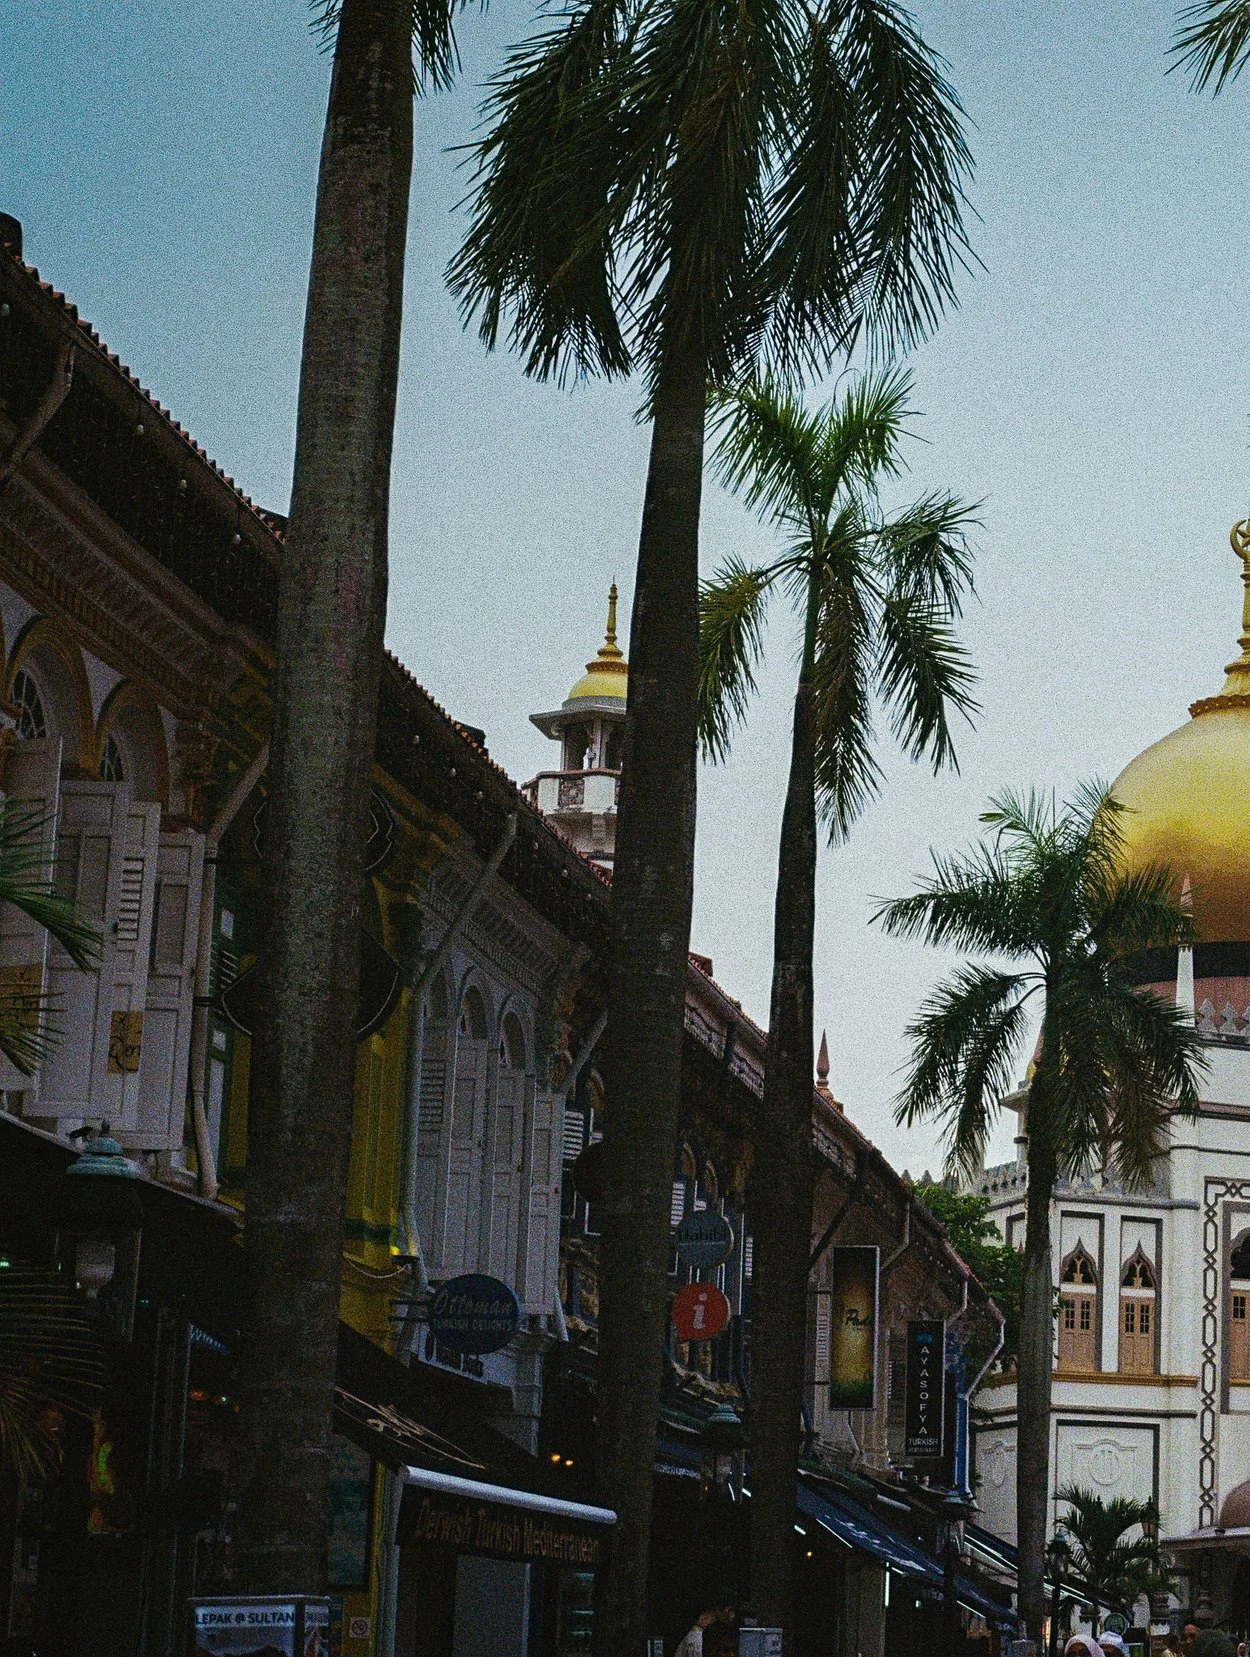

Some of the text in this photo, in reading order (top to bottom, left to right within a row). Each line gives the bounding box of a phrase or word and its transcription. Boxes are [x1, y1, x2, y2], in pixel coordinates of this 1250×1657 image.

[435, 1288, 512, 1315] Ottoman
[919, 1345, 930, 1435] AYASOFYA
[908, 1438, 938, 1446] TURKISH
[474, 1507, 520, 1553] Turkish
[196, 1612, 232, 1625] LEPAK
[235, 1612, 245, 1624] @
[248, 1611, 295, 1624] SULTAN
